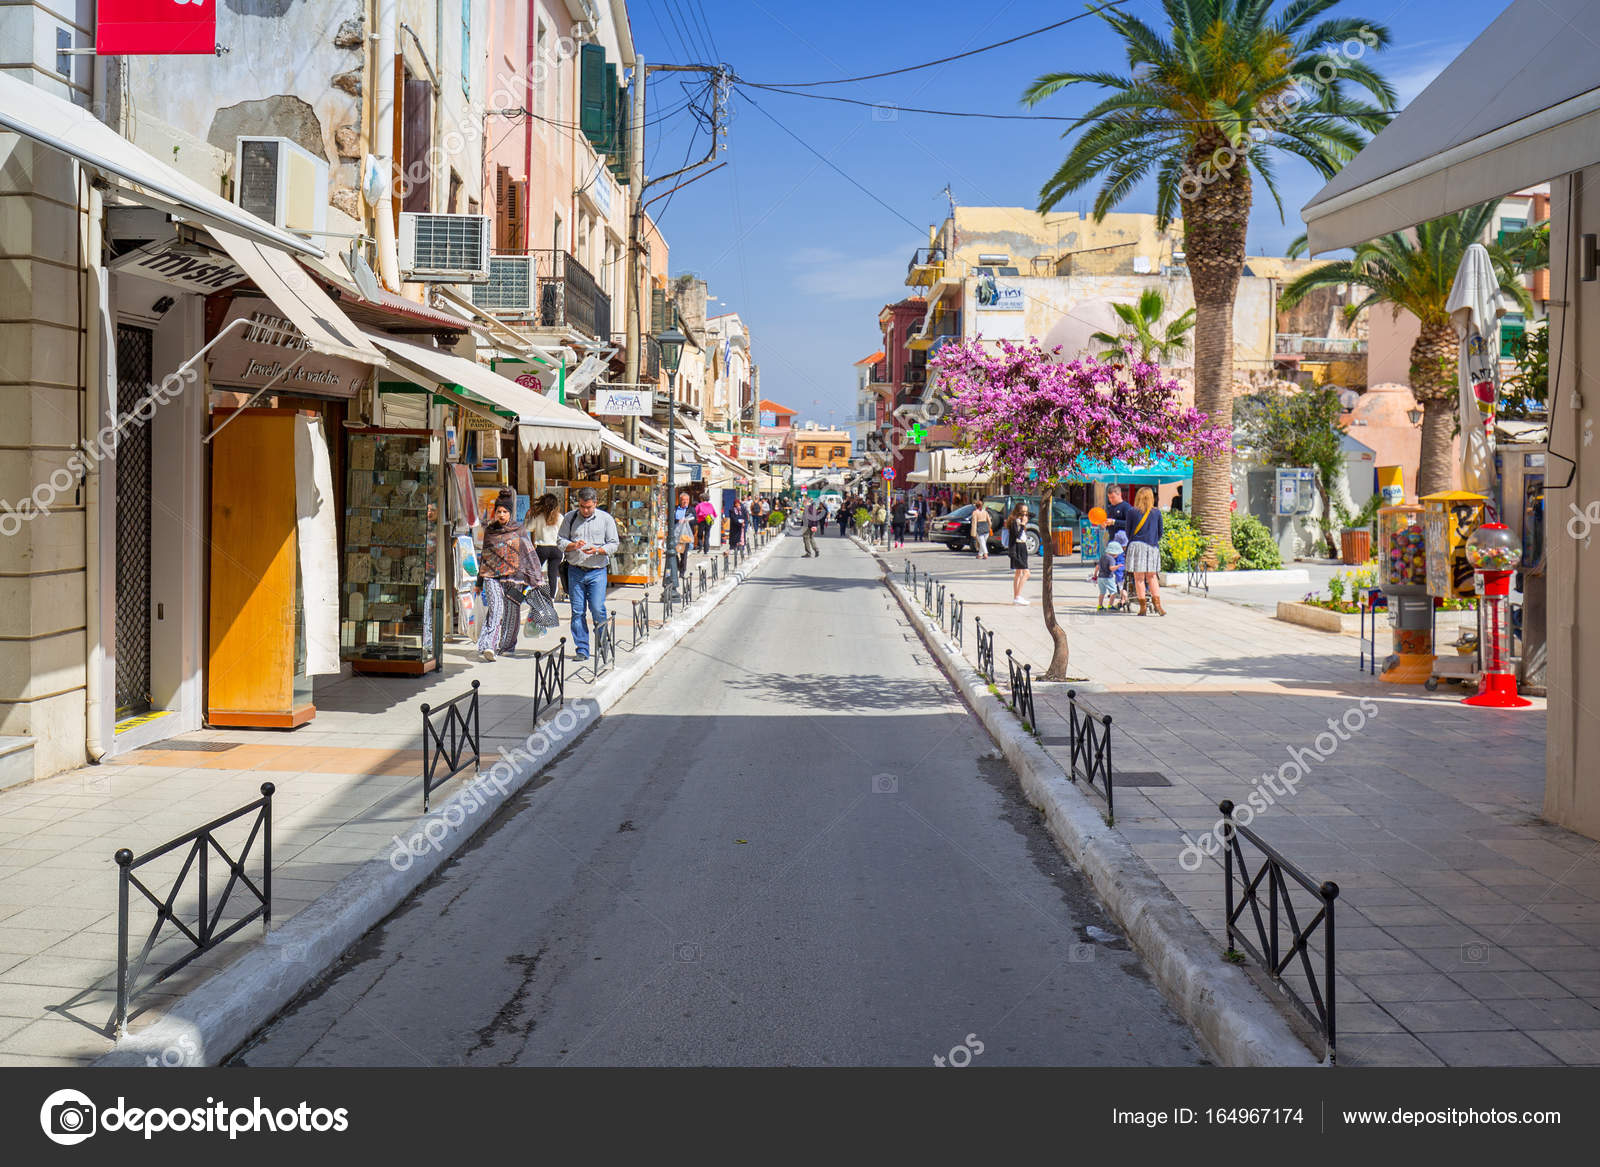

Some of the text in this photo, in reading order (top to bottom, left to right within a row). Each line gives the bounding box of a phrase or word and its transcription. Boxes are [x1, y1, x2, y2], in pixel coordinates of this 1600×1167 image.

[240, 359, 293, 384] Jewelly
[295, 366, 305, 381] &
[306, 369, 340, 385] watches
